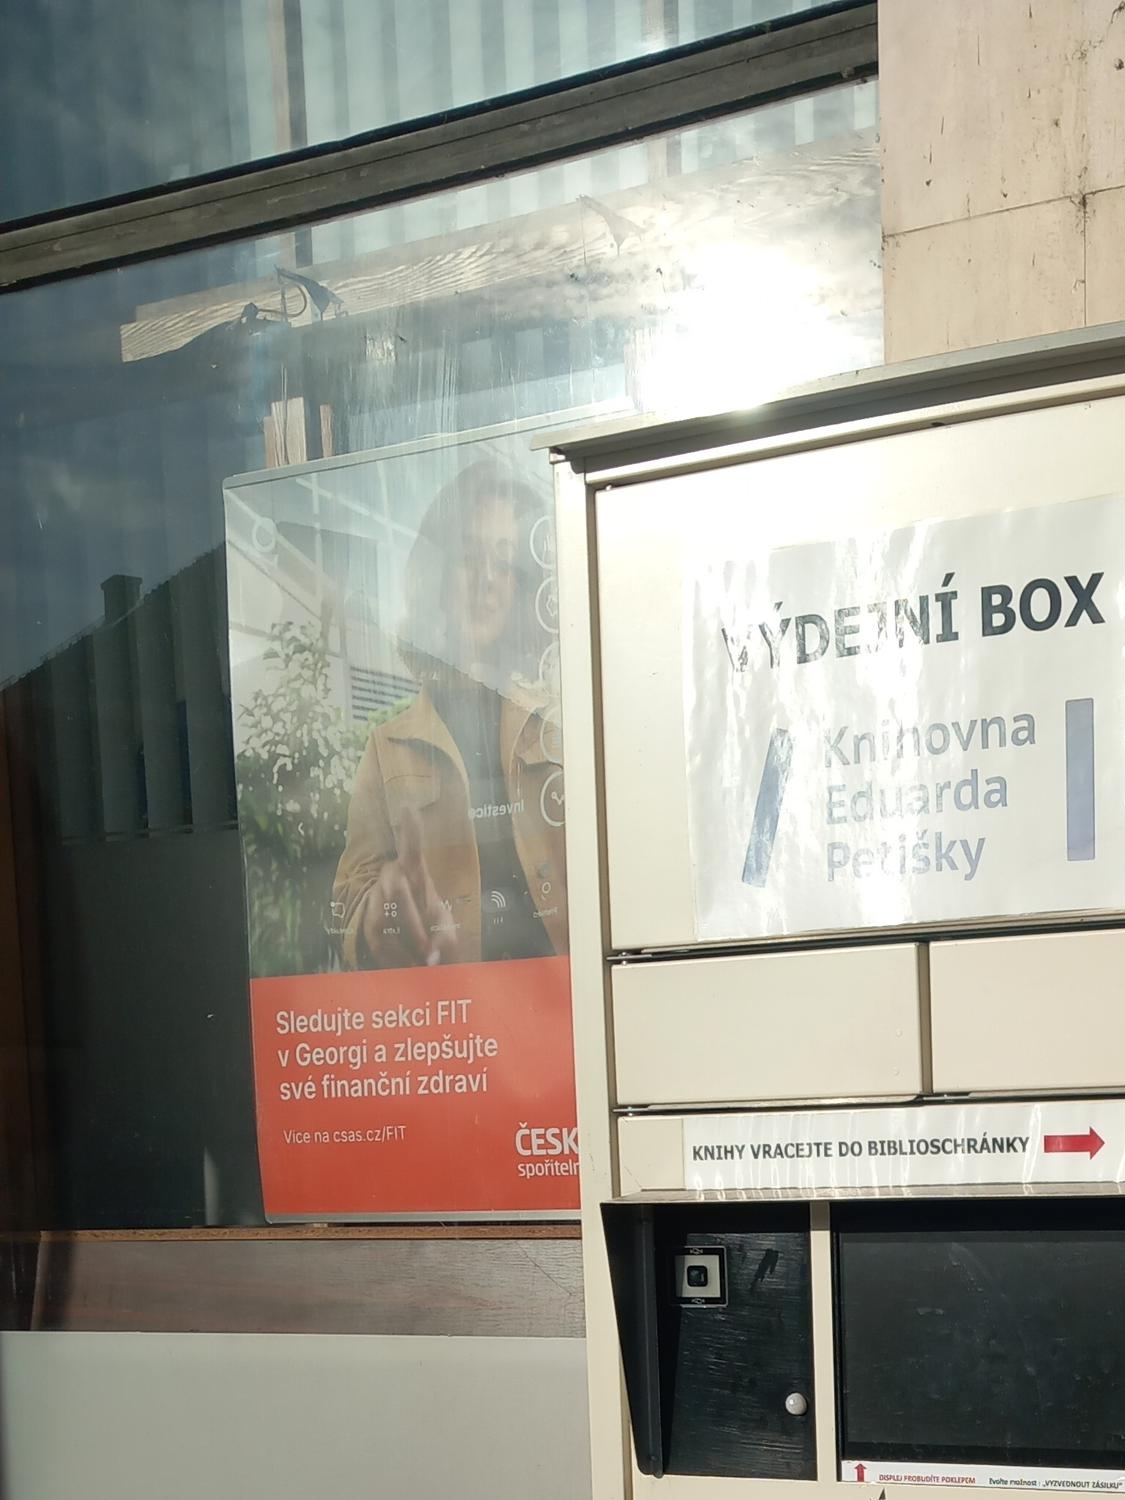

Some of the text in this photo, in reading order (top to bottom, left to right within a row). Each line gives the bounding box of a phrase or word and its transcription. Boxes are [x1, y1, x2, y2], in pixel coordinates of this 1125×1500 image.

[980, 572, 1106, 637] BOX
[824, 713, 1036, 768] Knihovna
[826, 769, 1008, 825] Eduarda
[827, 829, 986, 882] Petišky
[276, 999, 472, 1036] Sledujte sekci FIT
[277, 1033, 499, 1070] v Georgi a zlepšujte
[279, 1067, 488, 1101] své finanční zdraví
[314, 1131, 330, 1143] na
[333, 1125, 407, 1144] csas.cz/FIT
[692, 1132, 1030, 1161] KNIHY VRACEJTE DO BIBLIOSCHRÁNKY
